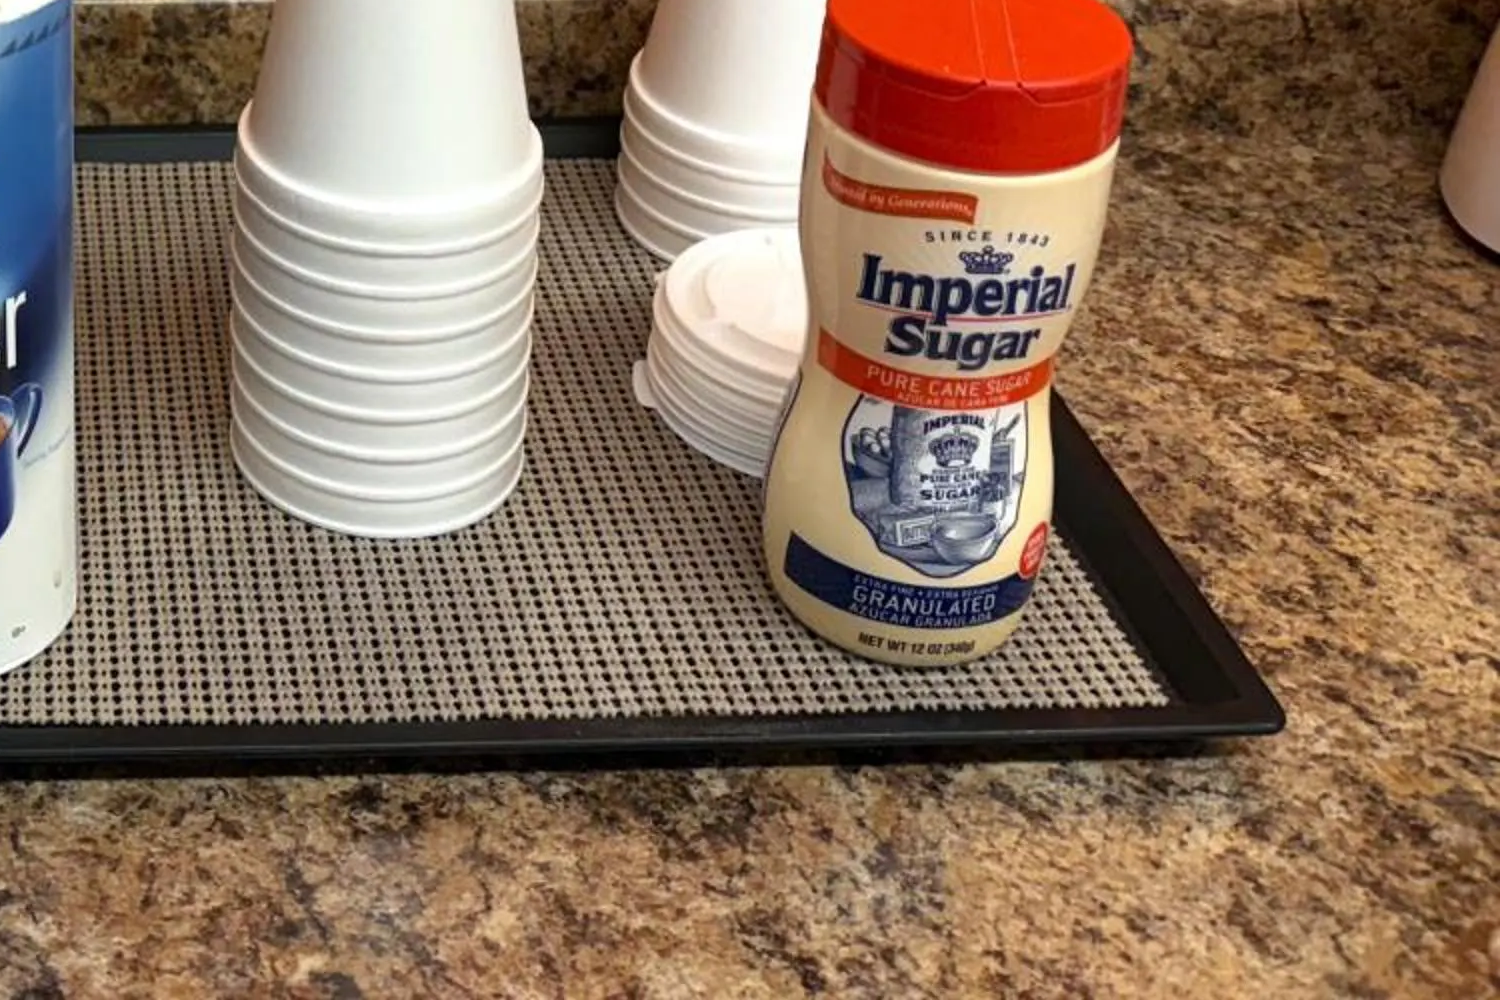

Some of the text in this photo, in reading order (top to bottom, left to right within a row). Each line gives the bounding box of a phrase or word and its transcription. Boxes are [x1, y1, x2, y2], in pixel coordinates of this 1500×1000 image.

[924, 230, 1051, 248] SINCE 1843
[855, 252, 1077, 327] Imperial
[883, 315, 1042, 372] Sugar
[867, 364, 1032, 398] PURE CANE SUGAR
[918, 485, 982, 500] SUGAR
[852, 584, 997, 617] GRANULATED
[858, 631, 885, 649] NET
[887, 638, 907, 653] WT
[911, 642, 925, 655] 12
